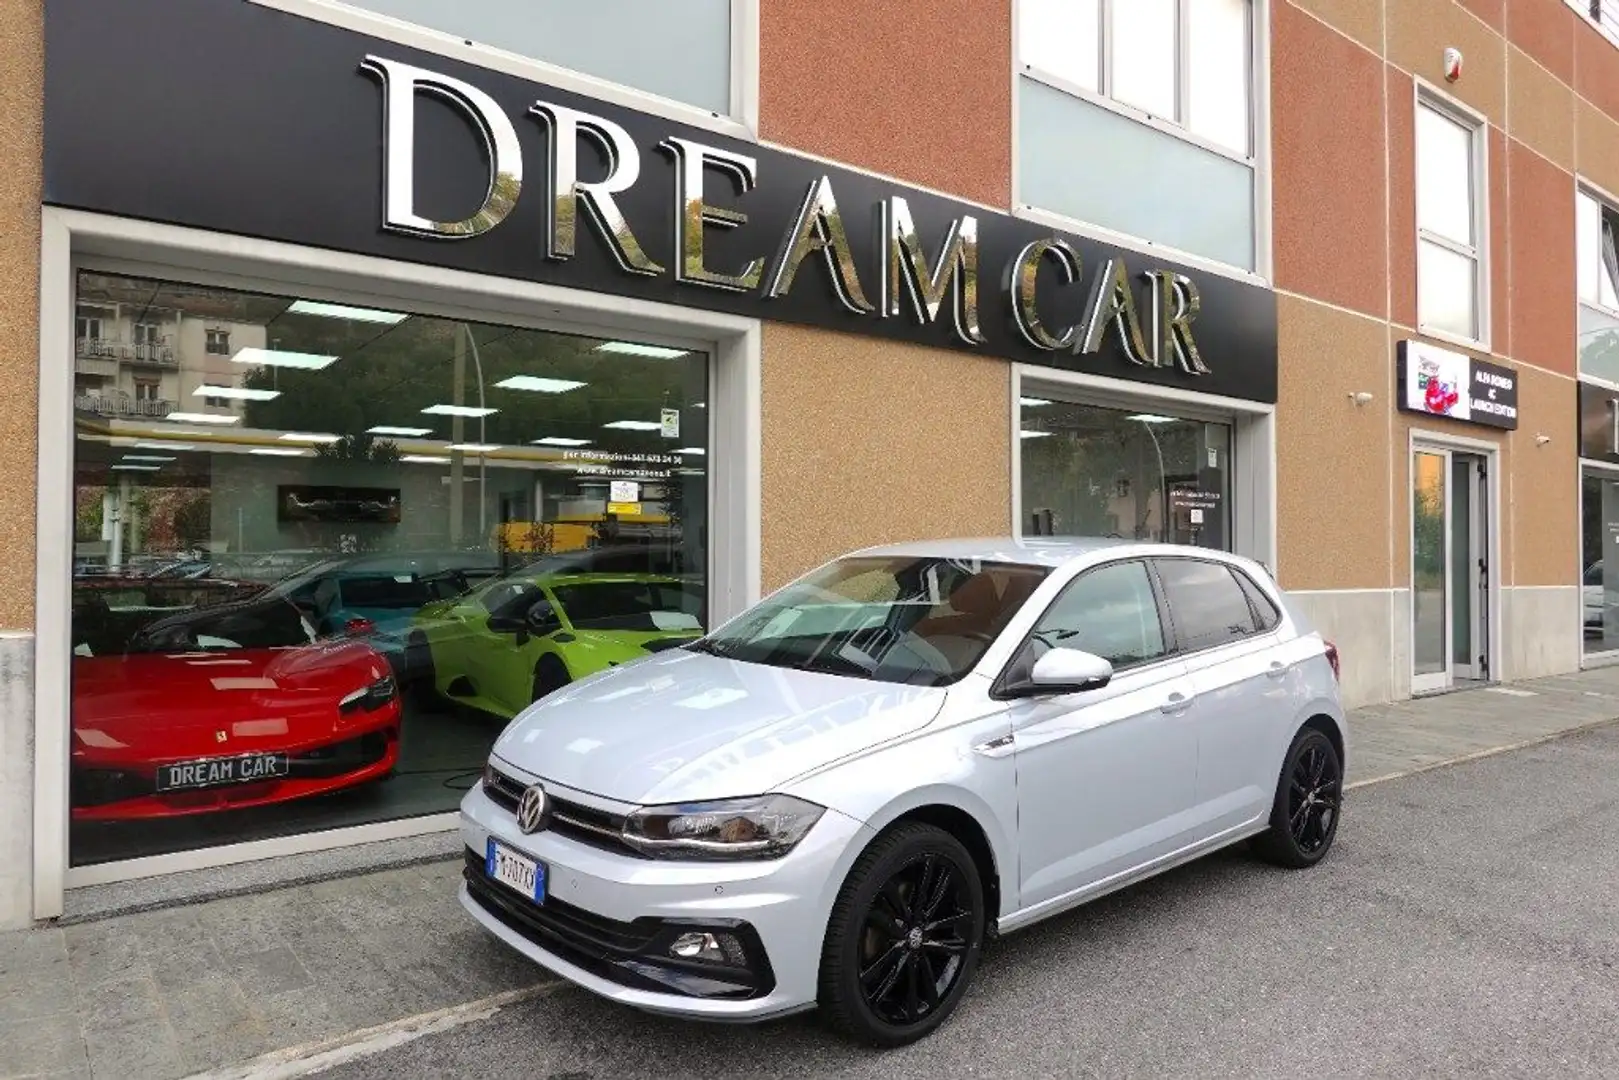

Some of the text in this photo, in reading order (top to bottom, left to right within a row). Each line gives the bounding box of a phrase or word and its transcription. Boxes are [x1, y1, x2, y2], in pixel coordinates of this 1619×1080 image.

[360, 54, 1212, 374] DREAM CAR
[169, 756, 277, 787] DREAM CAR
